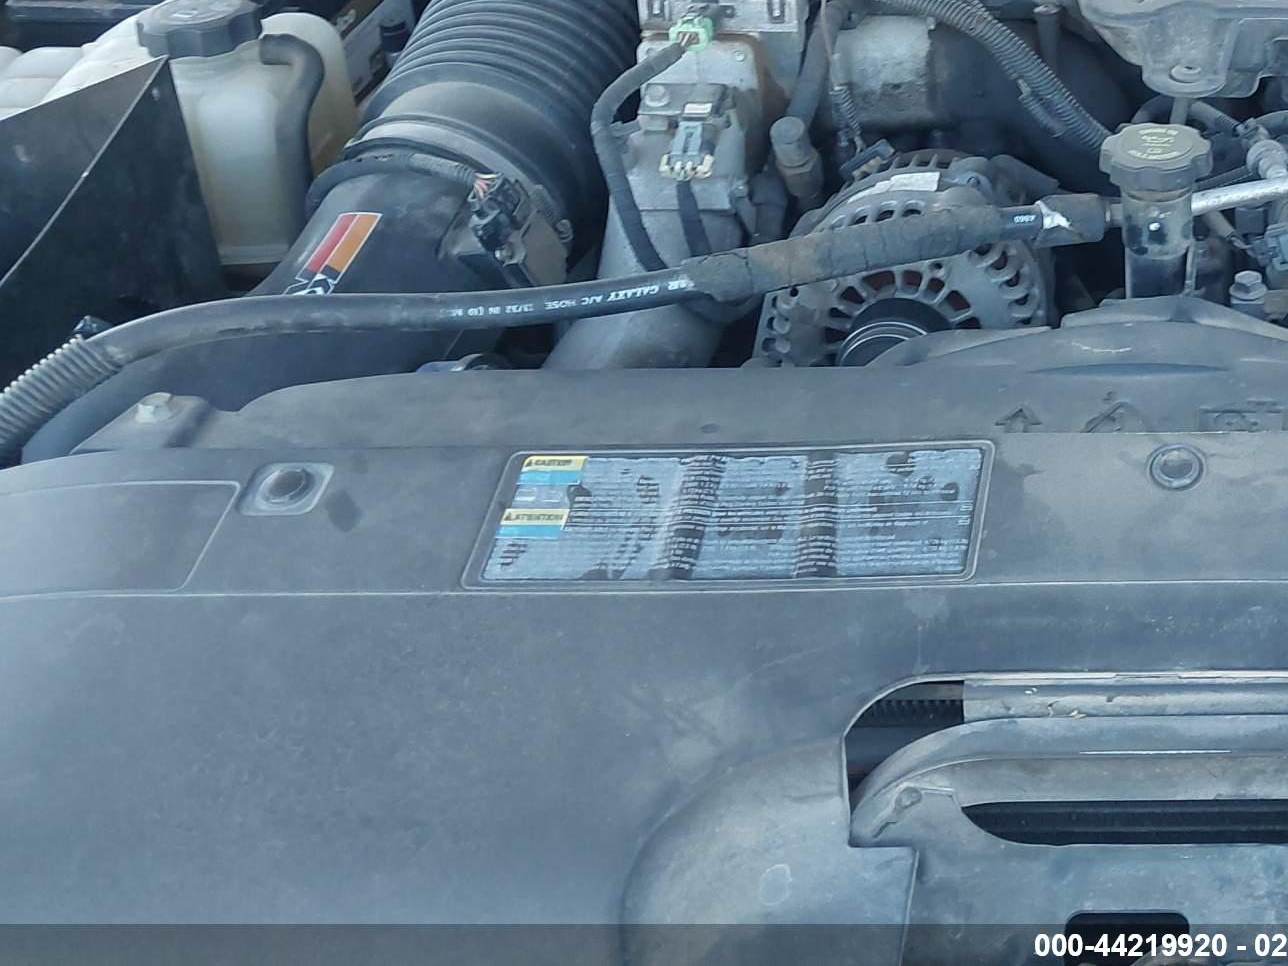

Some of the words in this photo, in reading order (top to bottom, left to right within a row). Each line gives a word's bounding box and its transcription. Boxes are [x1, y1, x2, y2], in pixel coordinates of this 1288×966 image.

[606, 284, 660, 303] GALAXY
[544, 299, 577, 311] HOSE
[581, 295, 604, 306] A/C
